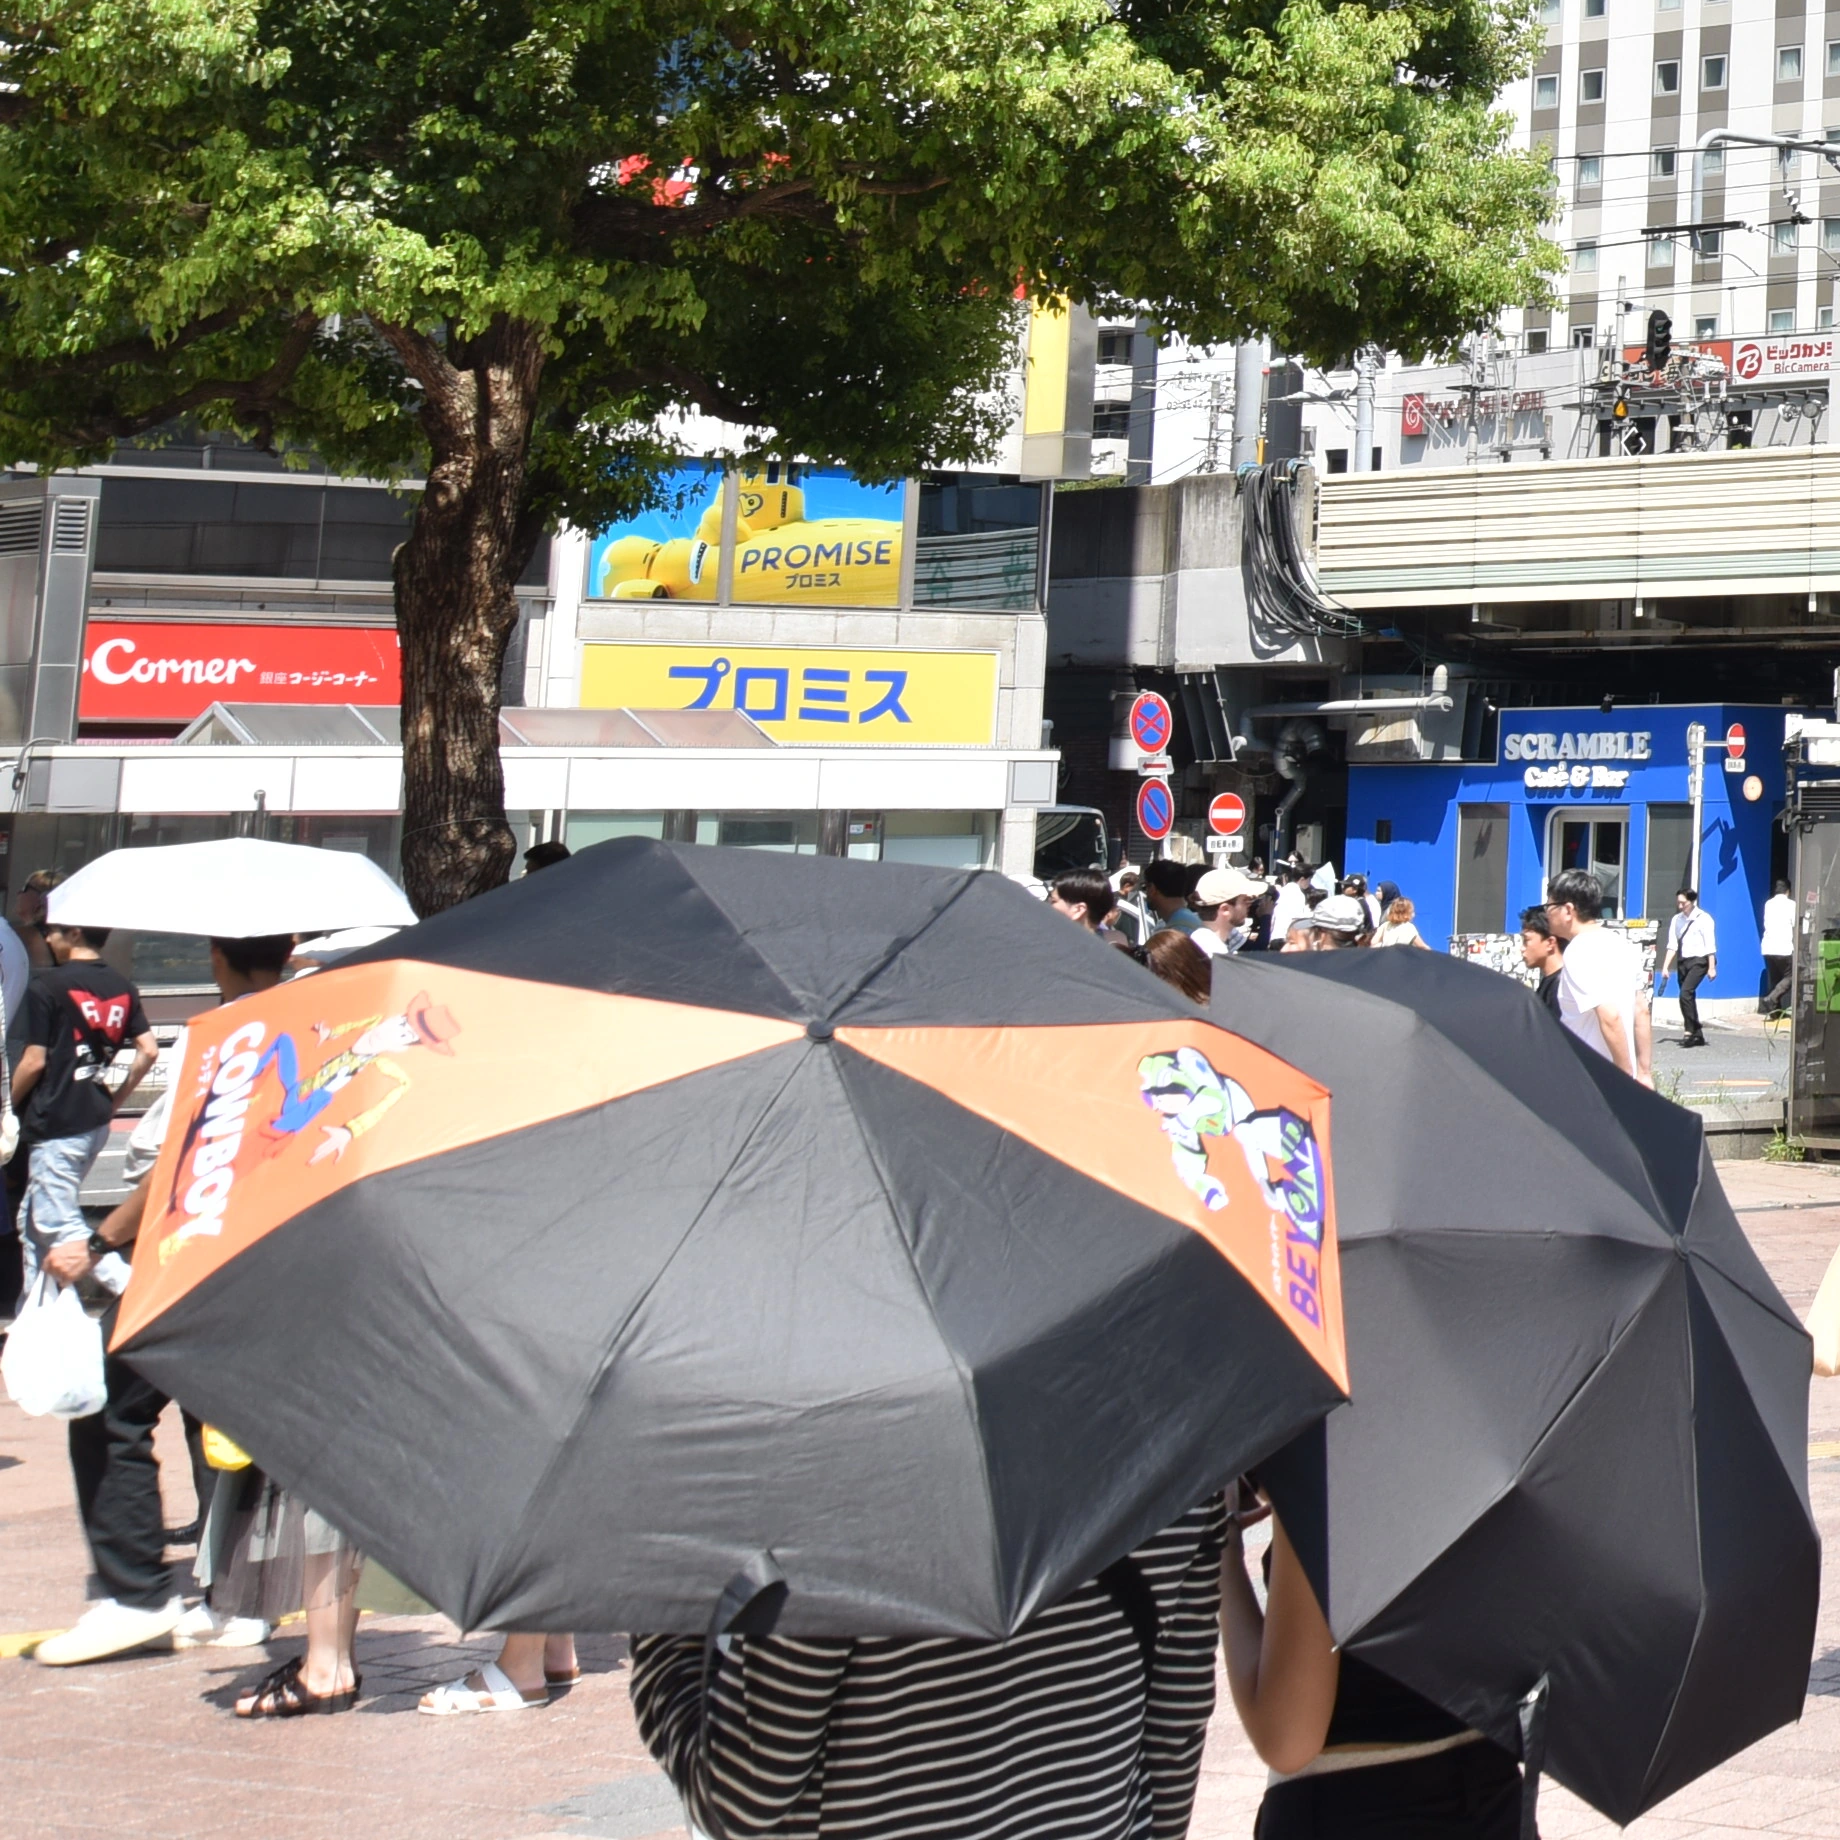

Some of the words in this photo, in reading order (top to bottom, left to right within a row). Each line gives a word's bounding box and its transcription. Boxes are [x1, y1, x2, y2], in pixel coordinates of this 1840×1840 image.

[1774, 361, 1831, 374] BicCamera
[740, 539, 892, 574] PROMISE
[785, 572, 842, 590] プロミス
[91, 637, 257, 686] Corner
[258, 670, 379, 688] 銀座コージーコーナー
[668, 656, 913, 724] プロミス
[1504, 731, 1652, 761] SCRAMBLE
[1524, 762, 1569, 788] Café
[1570, 765, 1591, 787] &
[1592, 766, 1630, 788] Bar
[179, 1020, 266, 1237] COWBOY
